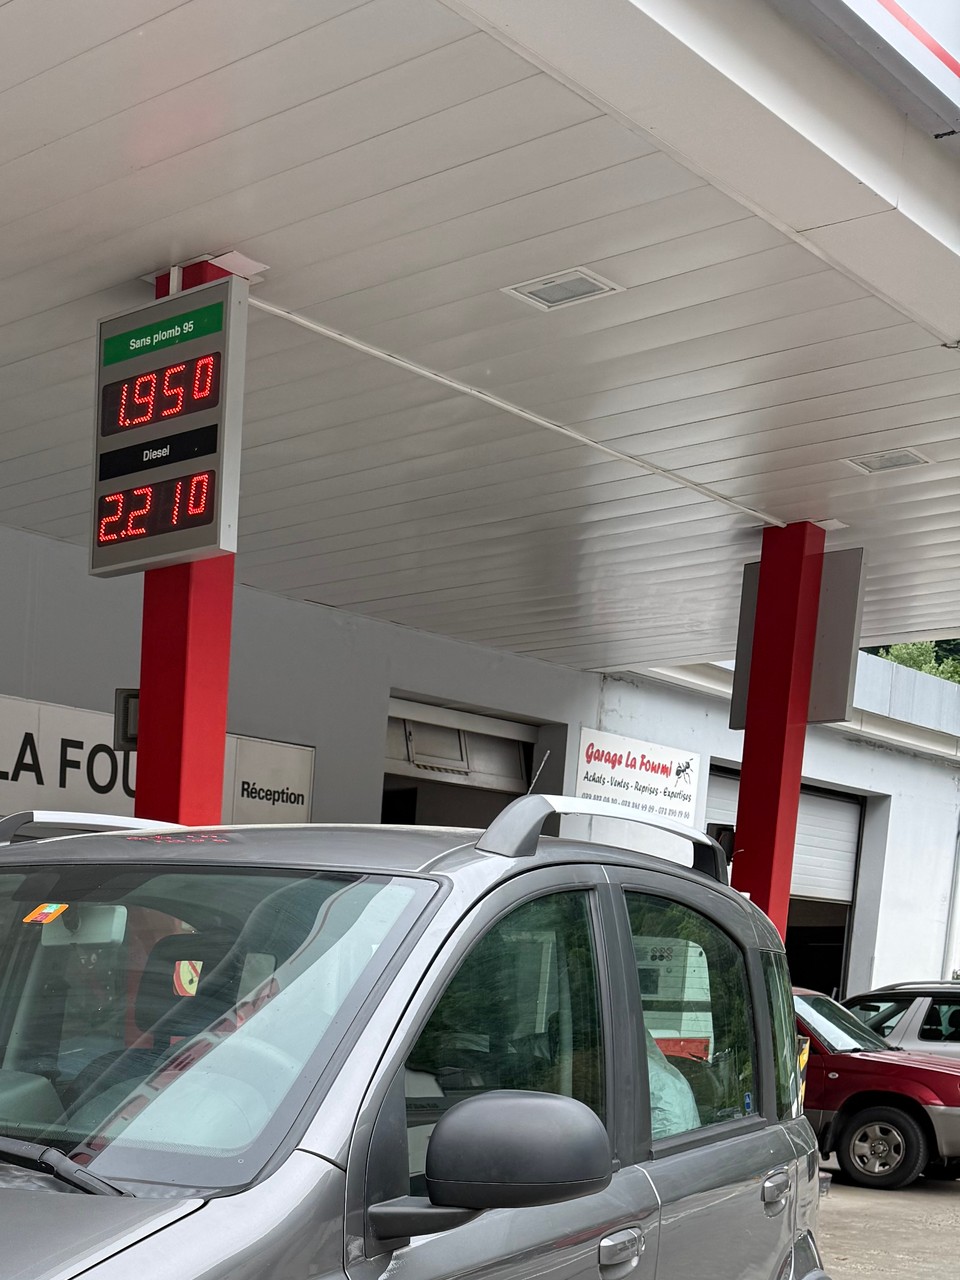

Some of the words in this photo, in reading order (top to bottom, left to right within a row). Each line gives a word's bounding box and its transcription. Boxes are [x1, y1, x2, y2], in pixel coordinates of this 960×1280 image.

[130, 336, 151, 350] Sans
[153, 325, 181, 345] plomb
[183, 320, 194, 334] 95
[143, 445, 170, 461] Diesel
[585, 742, 623, 770] Garage
[624, 751, 637, 770] La
[639, 754, 673, 779] Fourmi
[241, 780, 305, 806] Réception
[583, 771, 606, 786] Achats
[610, 776, 630, 791] Ventes
[634, 782, 659, 797] Reprises
[663, 787, 692, 803] Expertises
